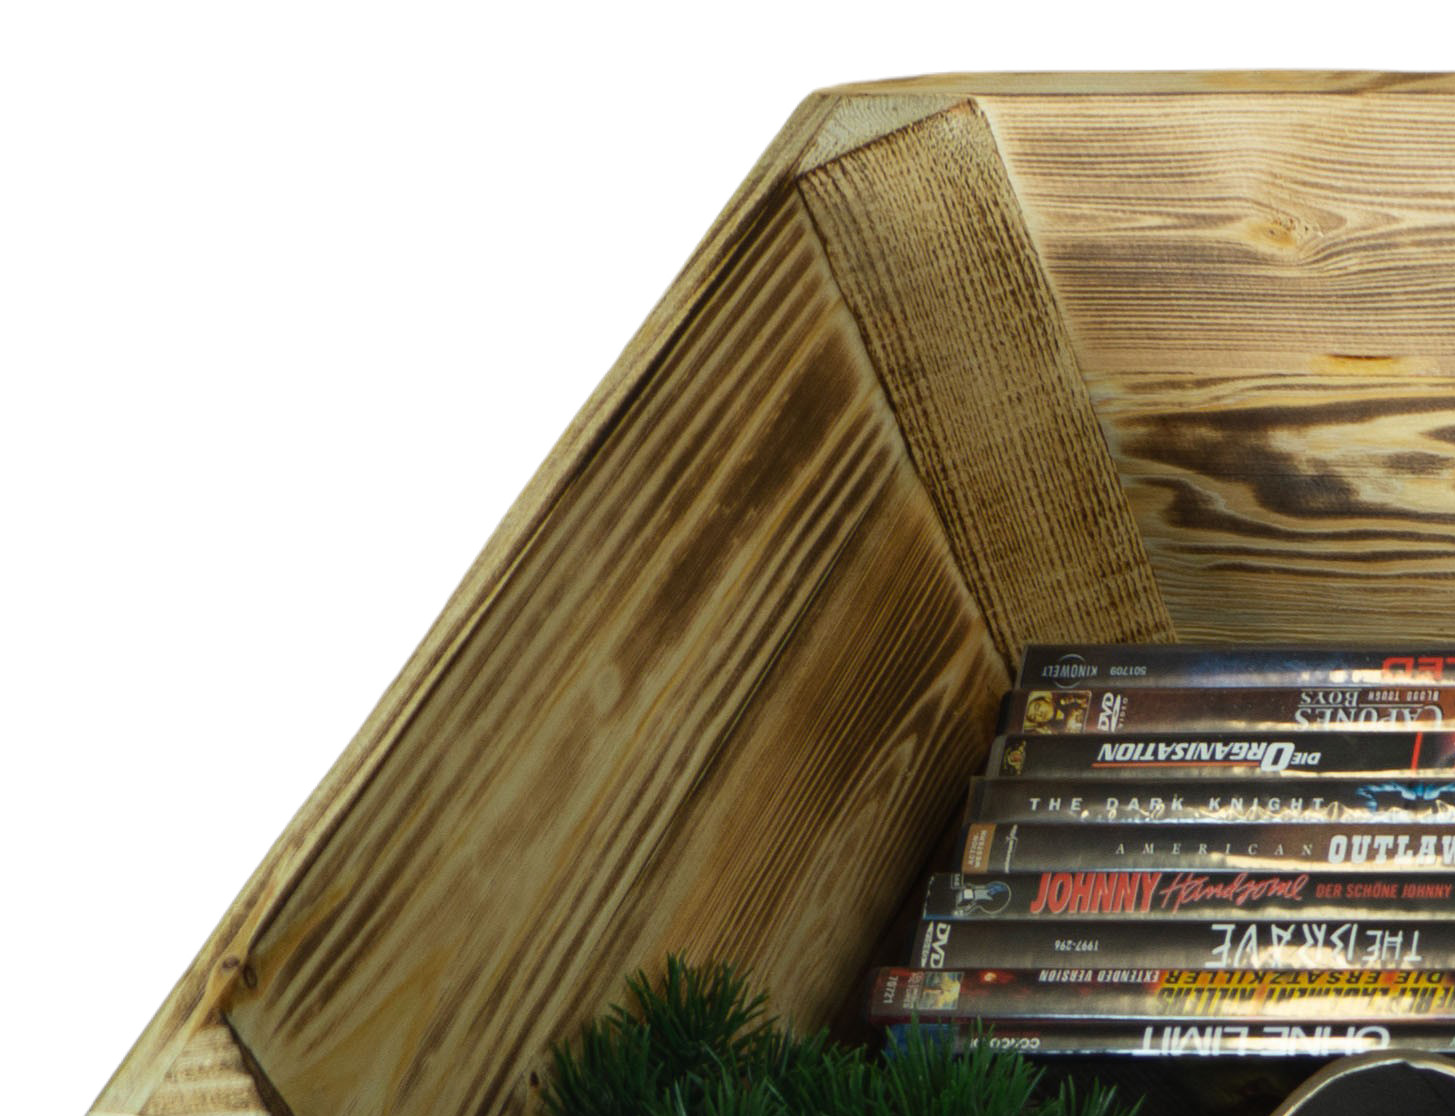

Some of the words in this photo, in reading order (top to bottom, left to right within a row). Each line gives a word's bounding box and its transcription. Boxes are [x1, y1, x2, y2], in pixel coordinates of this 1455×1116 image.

[1042, 665, 1098, 678] KINOWELT
[1301, 689, 1359, 706] BOYS
[1098, 742, 1295, 772] ORGANISATION
[1290, 752, 1322, 766] DIE
[1029, 798, 1083, 811] THE
[1105, 798, 1185, 811] DARK
[1208, 797, 1326, 811] KNIGHT
[1030, 872, 1163, 914] JOHNNY
[1315, 883, 1342, 898] DER
[1346, 881, 1398, 899] SCHÖNE
[1401, 883, 1453, 899] JOHNNY
[930, 922, 951, 968] DVD
[1363, 929, 1422, 962] THE
[1039, 969, 1093, 983] VERSION
[1098, 968, 1160, 983] EXTENDED
[1165, 969, 1379, 985] ERSATZKILLER
[1393, 970, 1446, 985] DIE
[1132, 1025, 1249, 1057] LIMIT
[1263, 1026, 1390, 1057] OHNE
